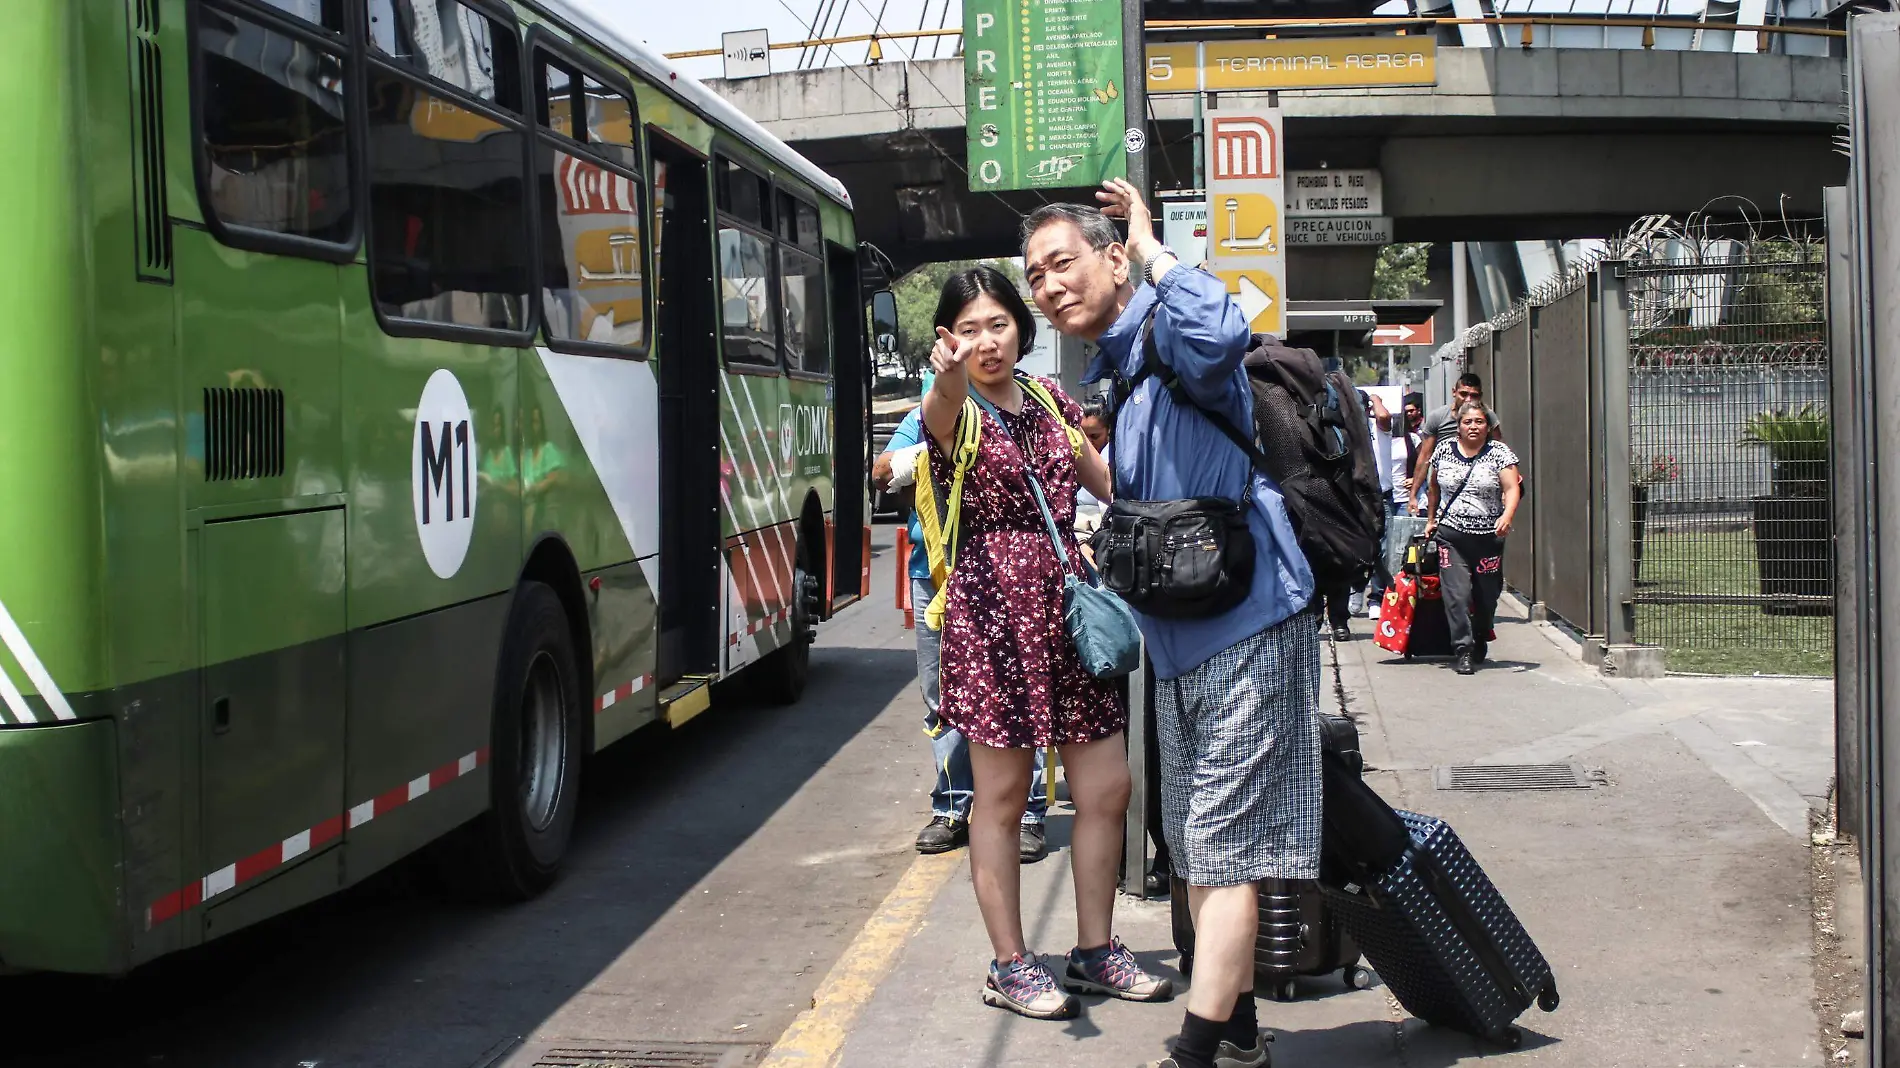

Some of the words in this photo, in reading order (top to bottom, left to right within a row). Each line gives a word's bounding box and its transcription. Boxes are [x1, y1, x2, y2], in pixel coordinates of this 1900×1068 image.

[1148, 56, 1173, 81] 5
[1215, 54, 1337, 73] TERMINAL
[1345, 53, 1424, 69] AEREA
[1038, 156, 1073, 180] rtp
[1334, 175, 1342, 188] EL
[1348, 175, 1364, 187] PASO
[1307, 198, 1338, 210] VEHICULOS
[1341, 197, 1368, 209] PESADOS
[1170, 211, 1184, 221] QUE
[1185, 210, 1195, 220] UN
[1293, 220, 1372, 232] PRECAUCION
[1285, 233, 1309, 243] RUCE
[1316, 233, 1328, 242] DE
[1336, 231, 1387, 242] VEHICULOS
[1343, 315, 1376, 323] MP164
[795, 404, 828, 456] CDMX
[420, 419, 470, 525] M1
